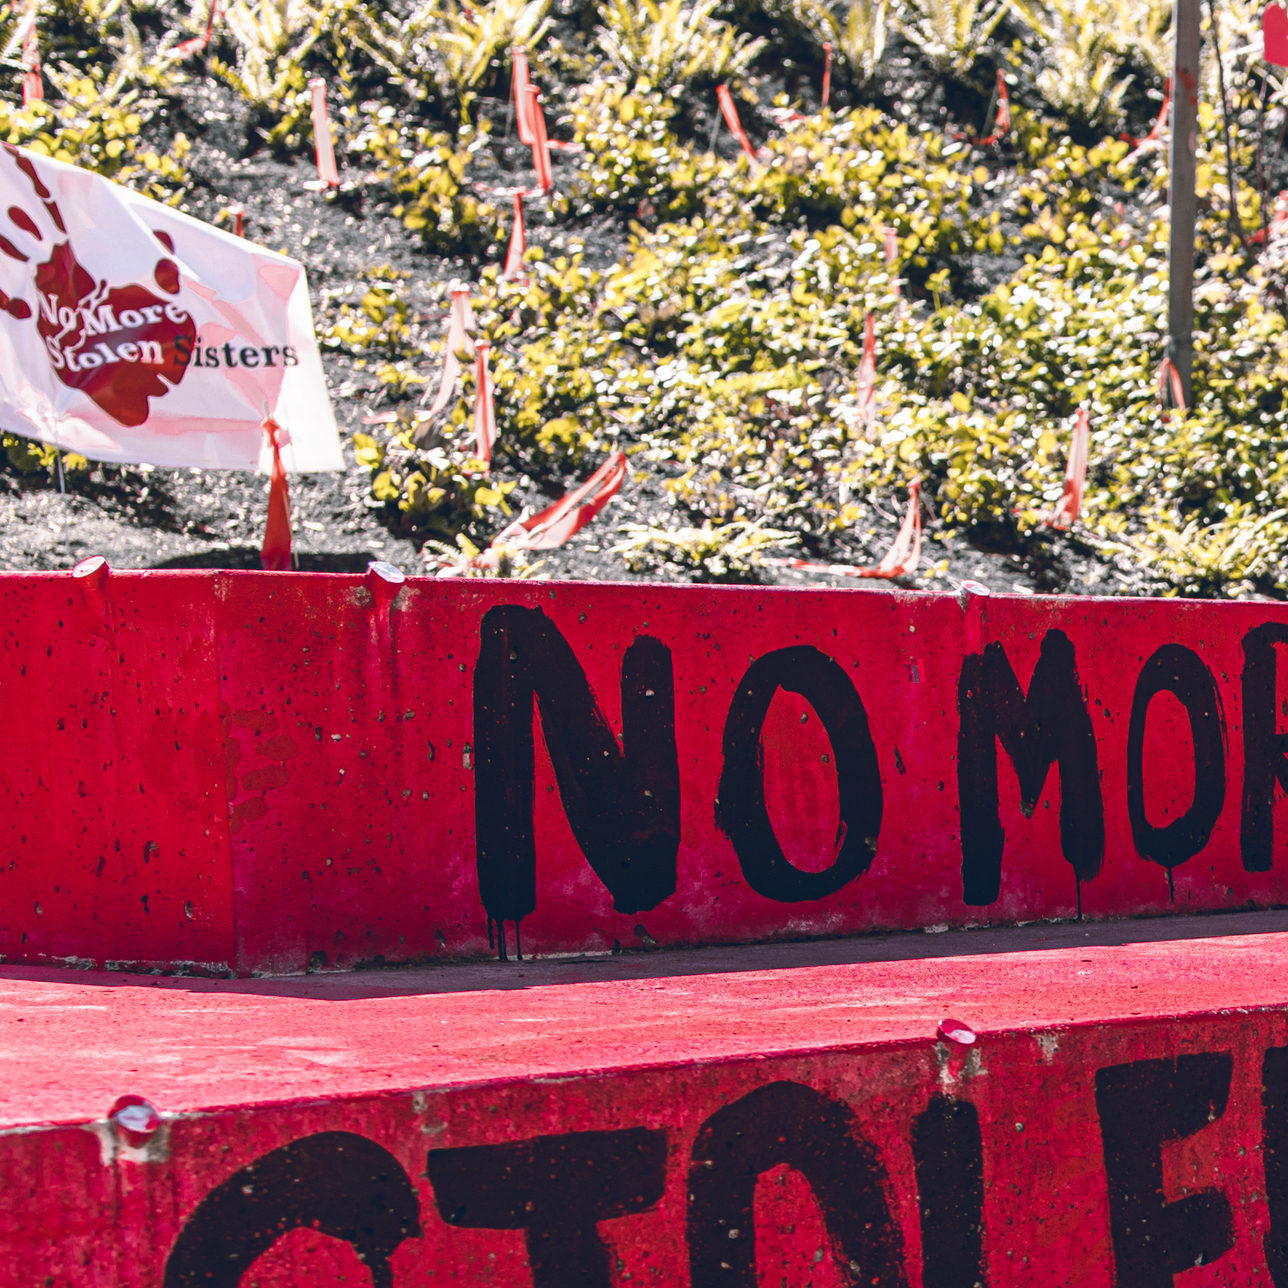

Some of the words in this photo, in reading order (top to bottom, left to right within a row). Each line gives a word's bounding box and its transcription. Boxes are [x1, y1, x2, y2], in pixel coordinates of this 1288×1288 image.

[79, 300, 188, 338] More
[45, 335, 164, 374] Stolen
[173, 334, 299, 369] Sisters
[472, 604, 884, 916] NO
